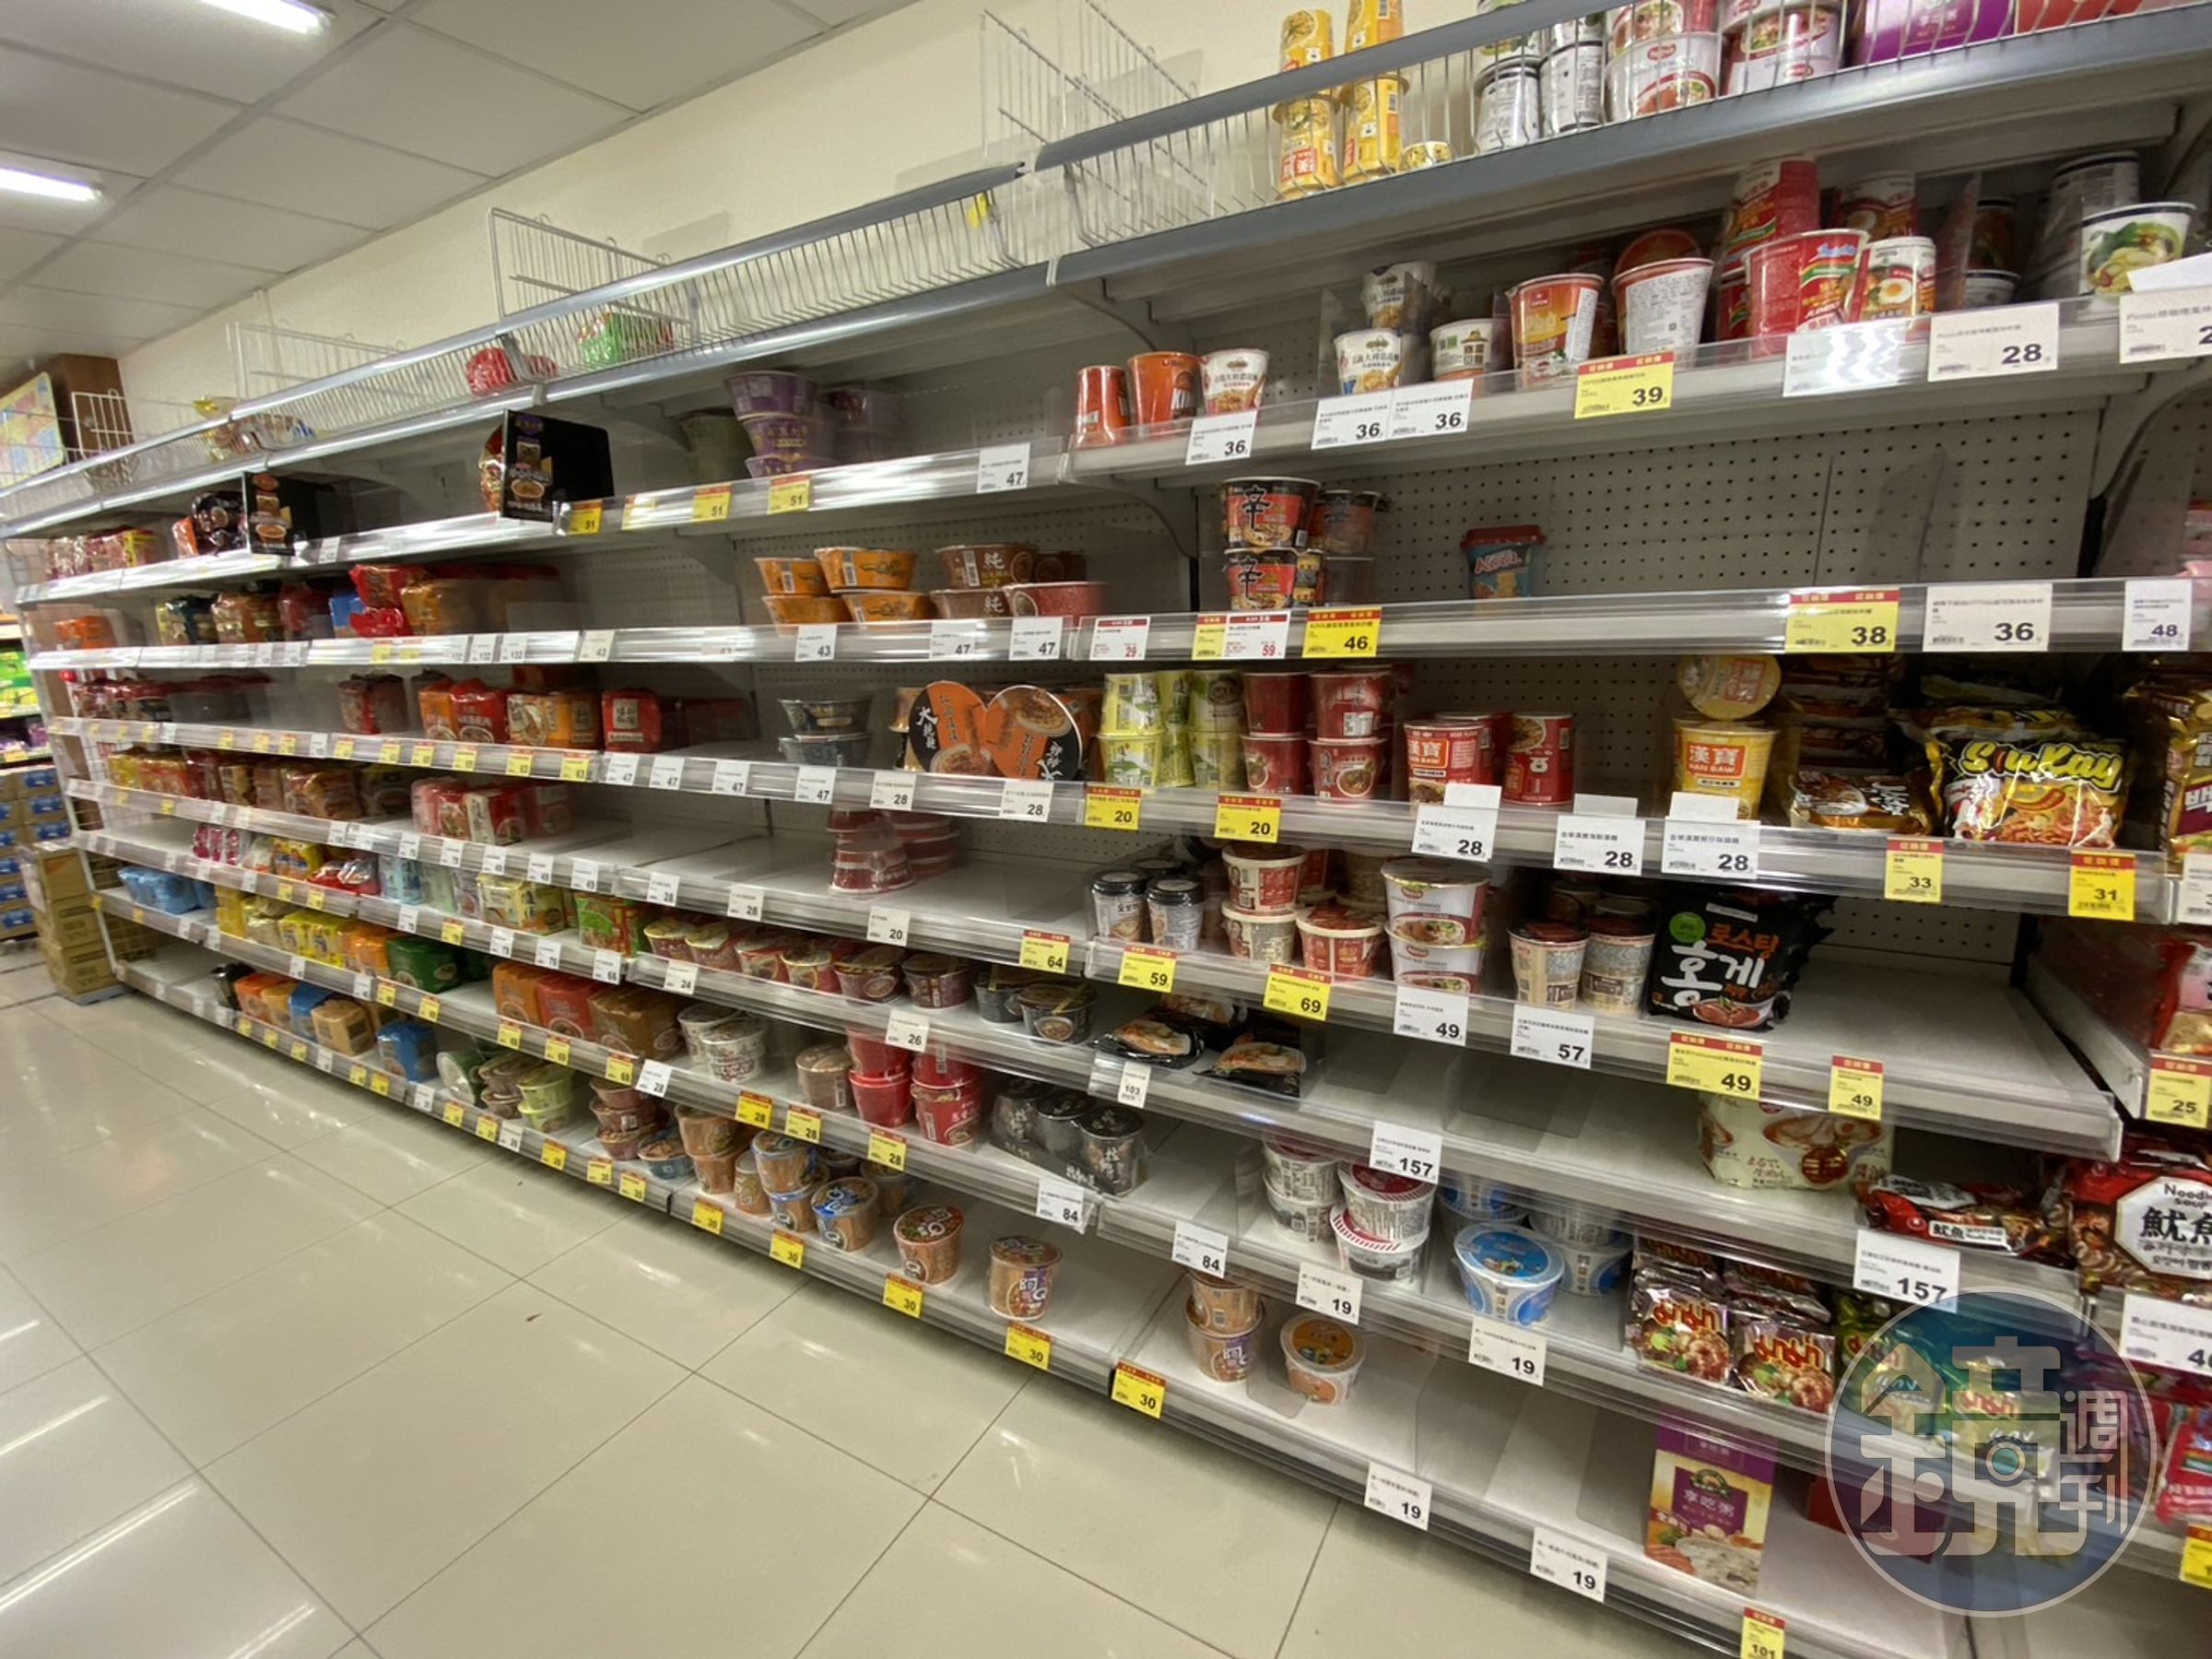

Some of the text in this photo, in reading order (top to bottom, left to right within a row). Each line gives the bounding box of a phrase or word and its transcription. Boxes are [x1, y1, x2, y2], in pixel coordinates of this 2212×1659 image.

[2002, 344, 2042, 365] 28
[1632, 386, 1664, 406] 39
[1435, 412, 1461, 429] 36
[1356, 423, 1380, 439] 36
[1224, 440, 1245, 455] 36
[1006, 472, 1024, 485] 47
[790, 495, 803, 506] 51
[1241, 484, 1272, 530] 辛
[712, 506, 724, 517] 51
[1238, 555, 1264, 601] 辛
[1852, 626, 1888, 645] 38
[1994, 622, 2034, 641] 36
[2152, 624, 2178, 637] 48
[955, 644, 971, 655] 47
[1039, 642, 1055, 654] 47
[1344, 635, 1369, 651] 46
[818, 646, 830, 657] 43
[1125, 646, 1137, 658] 29
[1262, 644, 1276, 657] 59
[732, 782, 744, 793] 47
[817, 790, 830, 800] 47
[894, 794, 908, 805] 28
[1028, 804, 1043, 816] 28
[1114, 810, 1133, 823] 20
[1250, 822, 1271, 835] 20
[1457, 839, 1483, 855] 28
[1605, 851, 1633, 868] 28
[1718, 854, 1749, 871] 28
[1910, 877, 1932, 888] 33
[2094, 888, 2117, 900] 31
[889, 928, 903, 939] 20
[1047, 957, 1063, 968] 64
[1150, 972, 1168, 986] 59
[1660, 938, 1766, 1007] 홍게
[1300, 998, 1322, 1013] 69
[1436, 1023, 1460, 1039] 49
[908, 1034, 922, 1045] 26
[1559, 1044, 1585, 1061] 57
[1721, 1074, 1752, 1091] 49
[1851, 1094, 1873, 1106] 49
[2172, 1100, 2197, 1113] 25
[754, 1112, 766, 1122] 28
[806, 1128, 818, 1139] 28
[888, 1154, 901, 1166] 28
[1399, 1157, 1433, 1177] 157
[1063, 1208, 1078, 1221] 84
[787, 1252, 799, 1263] 30
[1202, 1255, 1220, 1272] 84
[1898, 1277, 1947, 1300] 157
[904, 1298, 916, 1309] 30
[1333, 1298, 1352, 1314] 19
[1030, 1349, 1044, 1362] 30
[1512, 1357, 1535, 1374] 19
[1140, 1393, 1157, 1410] 30
[1402, 1501, 1421, 1519] 19
[1573, 1571, 1596, 1590] 19
[1752, 1644, 1775, 1659] 101
